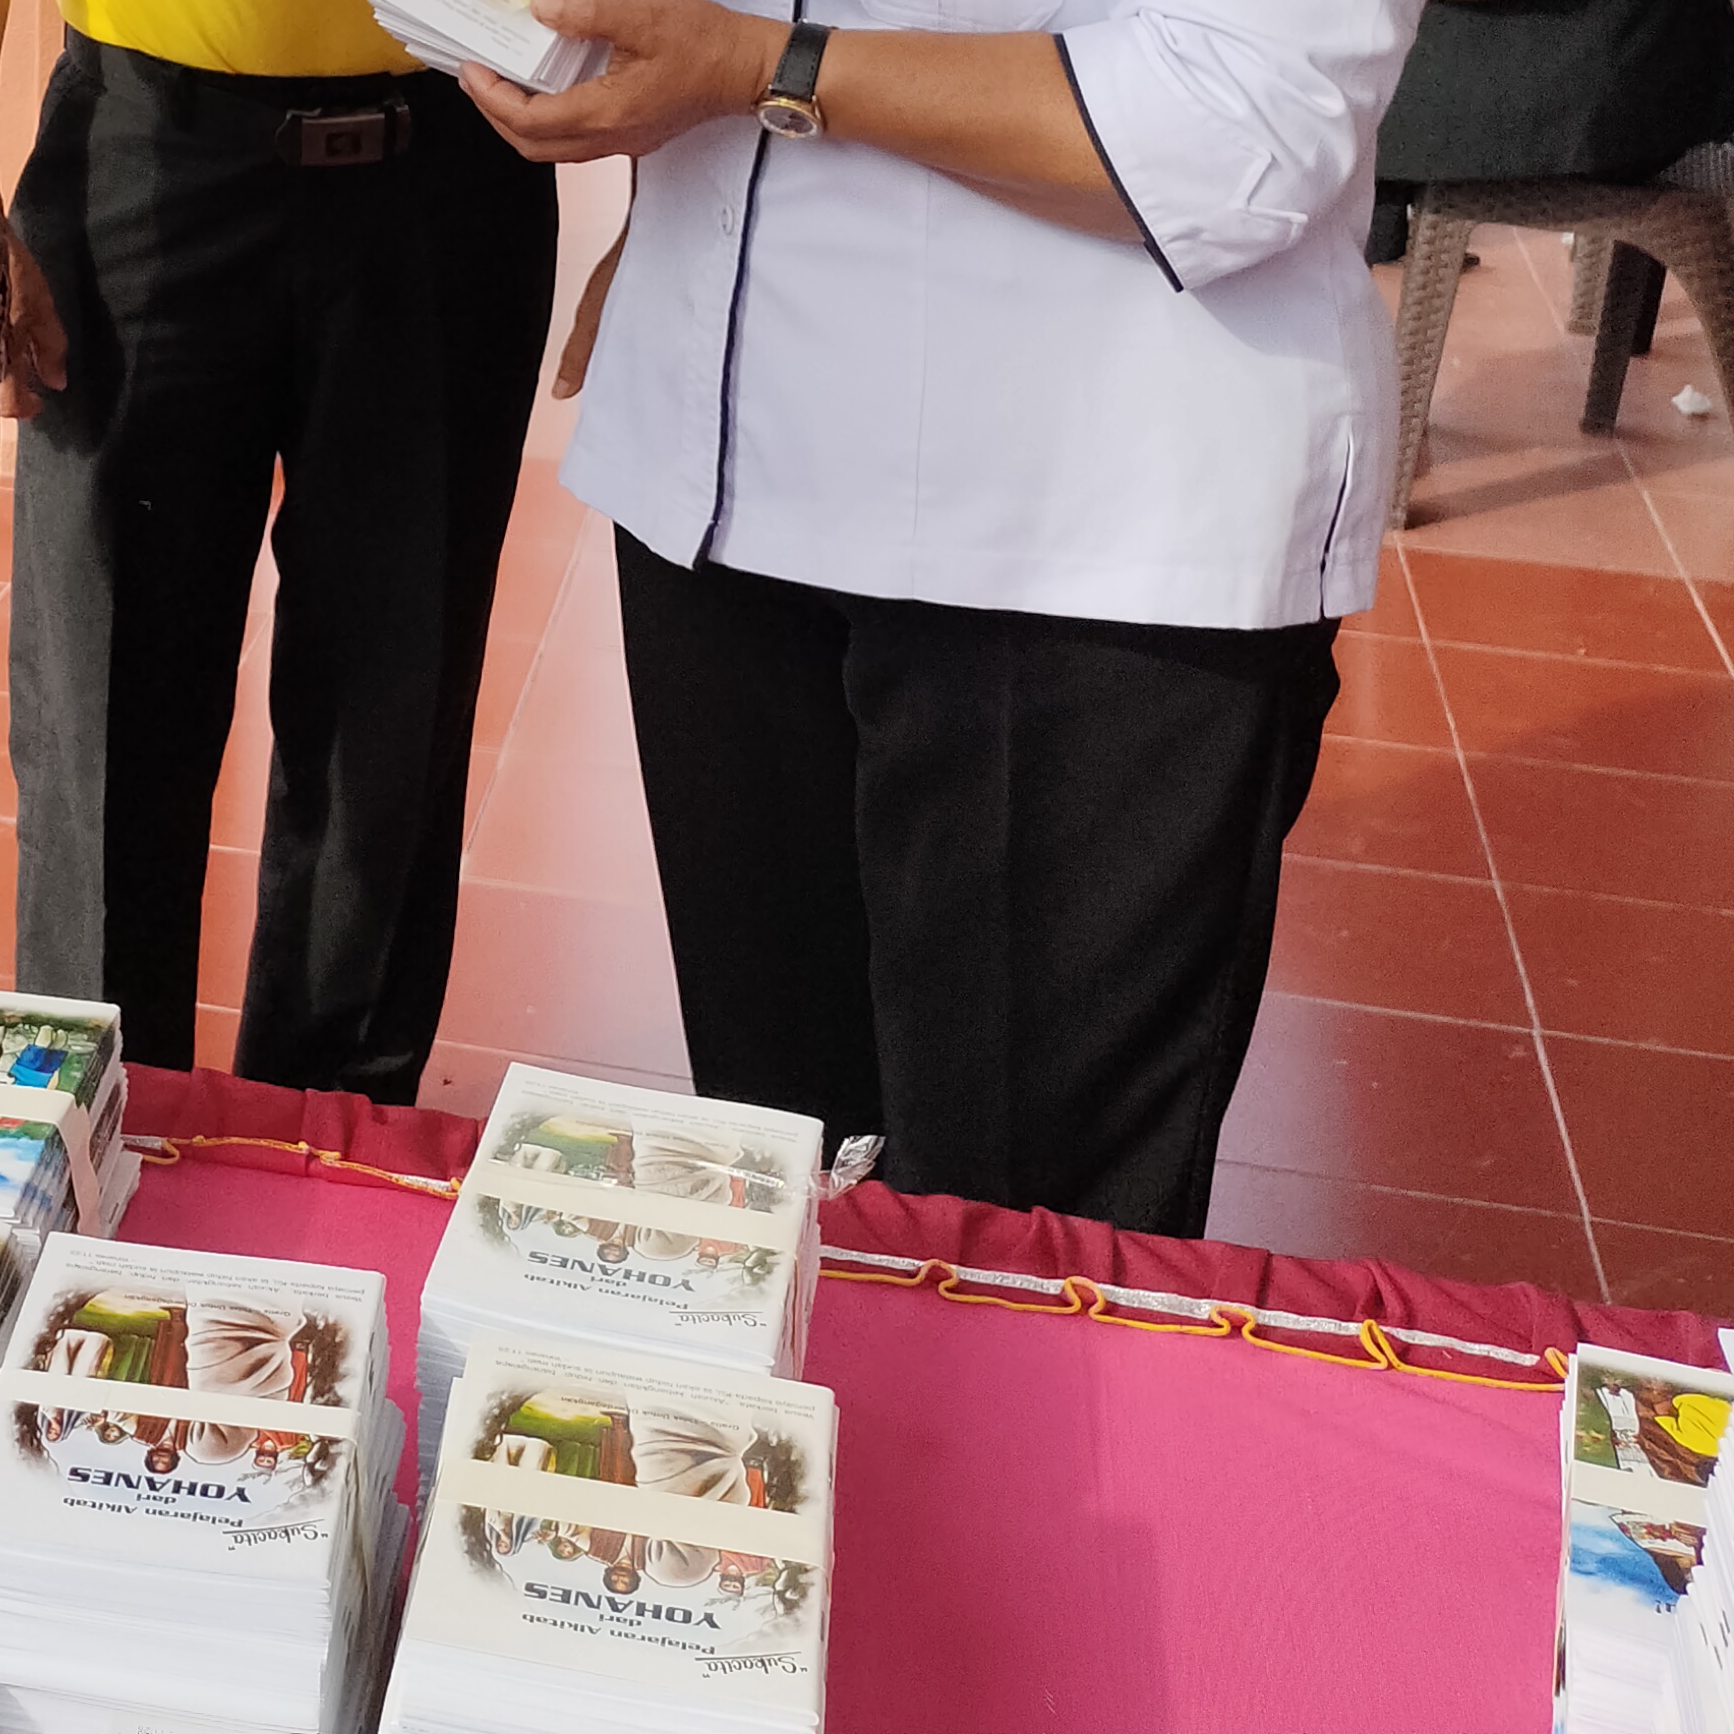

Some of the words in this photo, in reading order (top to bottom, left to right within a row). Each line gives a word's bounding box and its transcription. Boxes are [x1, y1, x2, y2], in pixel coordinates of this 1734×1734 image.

[527, 1250, 696, 1292] YOHANES
[590, 1276, 627, 1287] dari
[524, 1273, 593, 1292] Alkitab
[598, 1287, 689, 1310] Pelajaran
[67, 1466, 252, 1504] YOHANES
[63, 1497, 138, 1515] Alkitab
[136, 1493, 176, 1504] dari
[145, 1507, 244, 1529] Pelajaran
[524, 1581, 722, 1630] YOHANES
[521, 1613, 601, 1635] Alkitab
[599, 1613, 642, 1627] dari
[609, 1630, 716, 1655] Pelajaran
